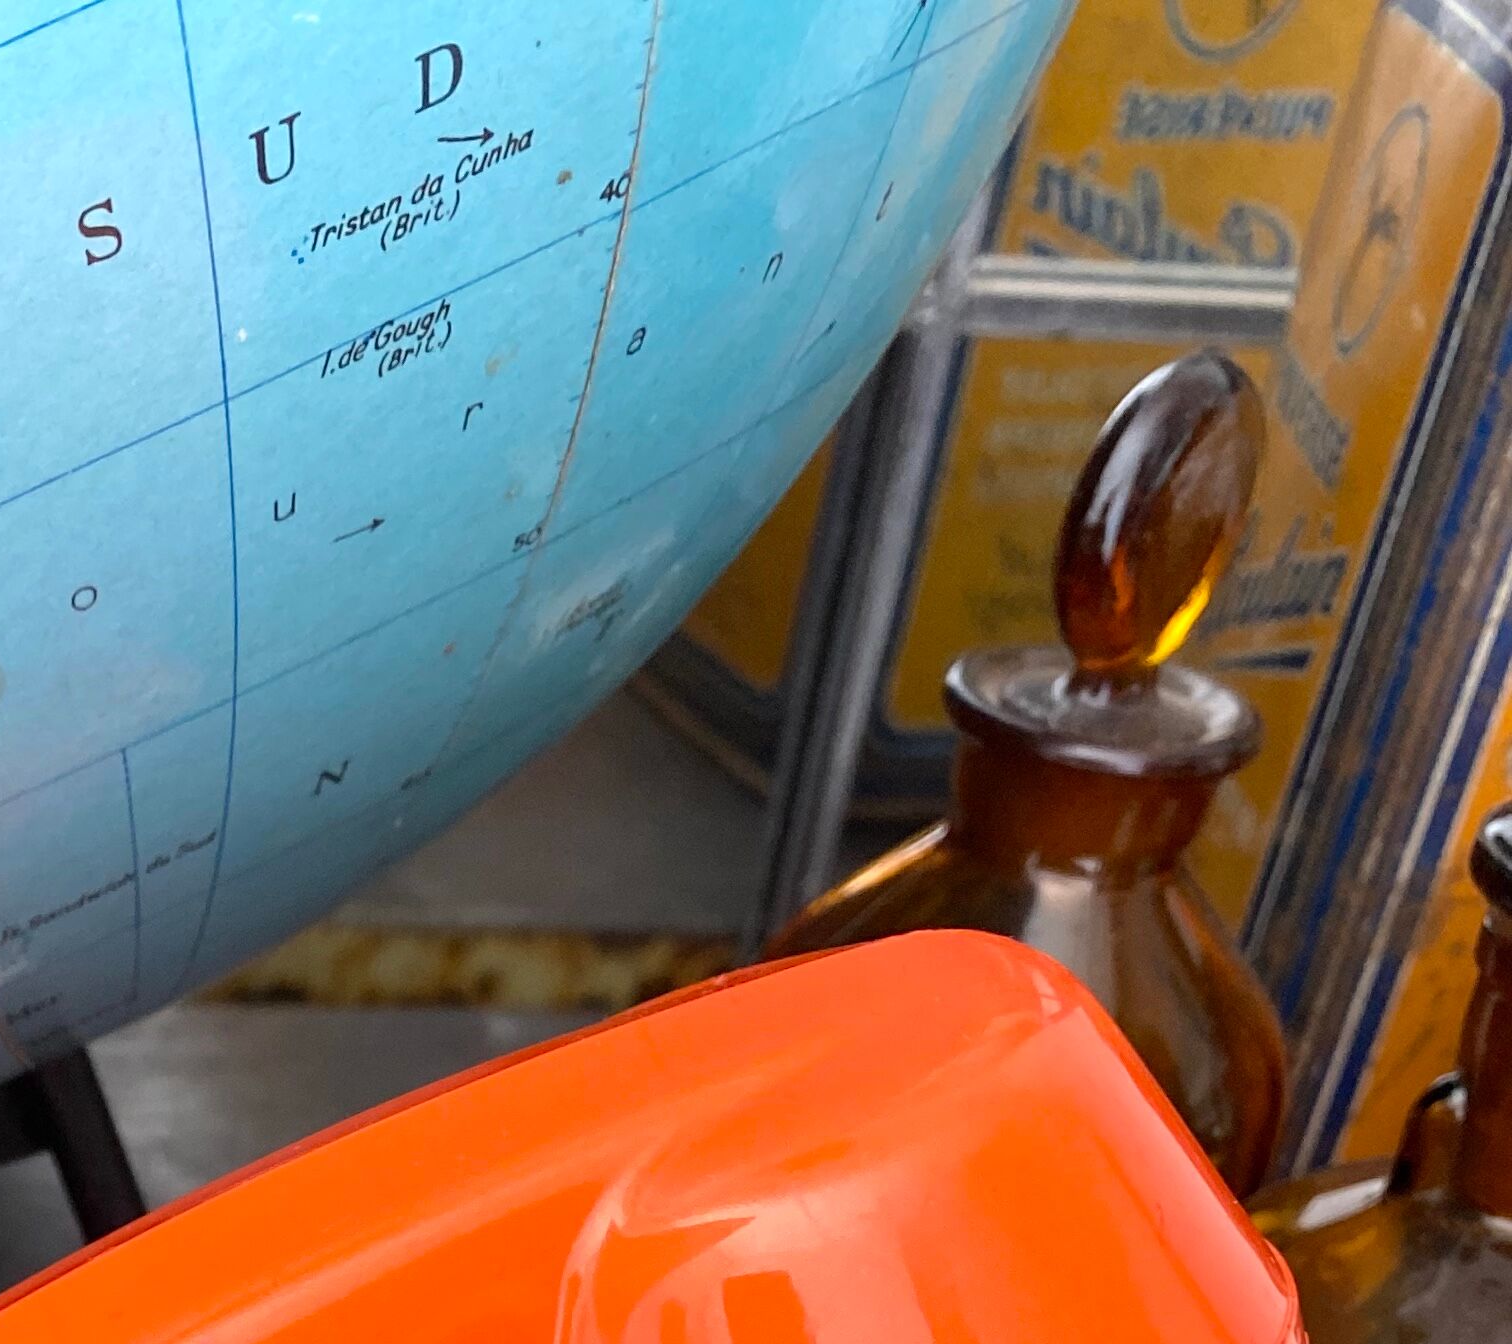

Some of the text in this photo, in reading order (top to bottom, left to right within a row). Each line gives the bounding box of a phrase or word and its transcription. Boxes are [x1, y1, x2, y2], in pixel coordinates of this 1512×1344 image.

[311, 129, 534, 252] Tristan da Cunha
[600, 170, 630, 203] 40
[381, 189, 460, 251] (Brit.)
[374, 299, 451, 350] Gough
[378, 321, 452, 377] (Brit.)
